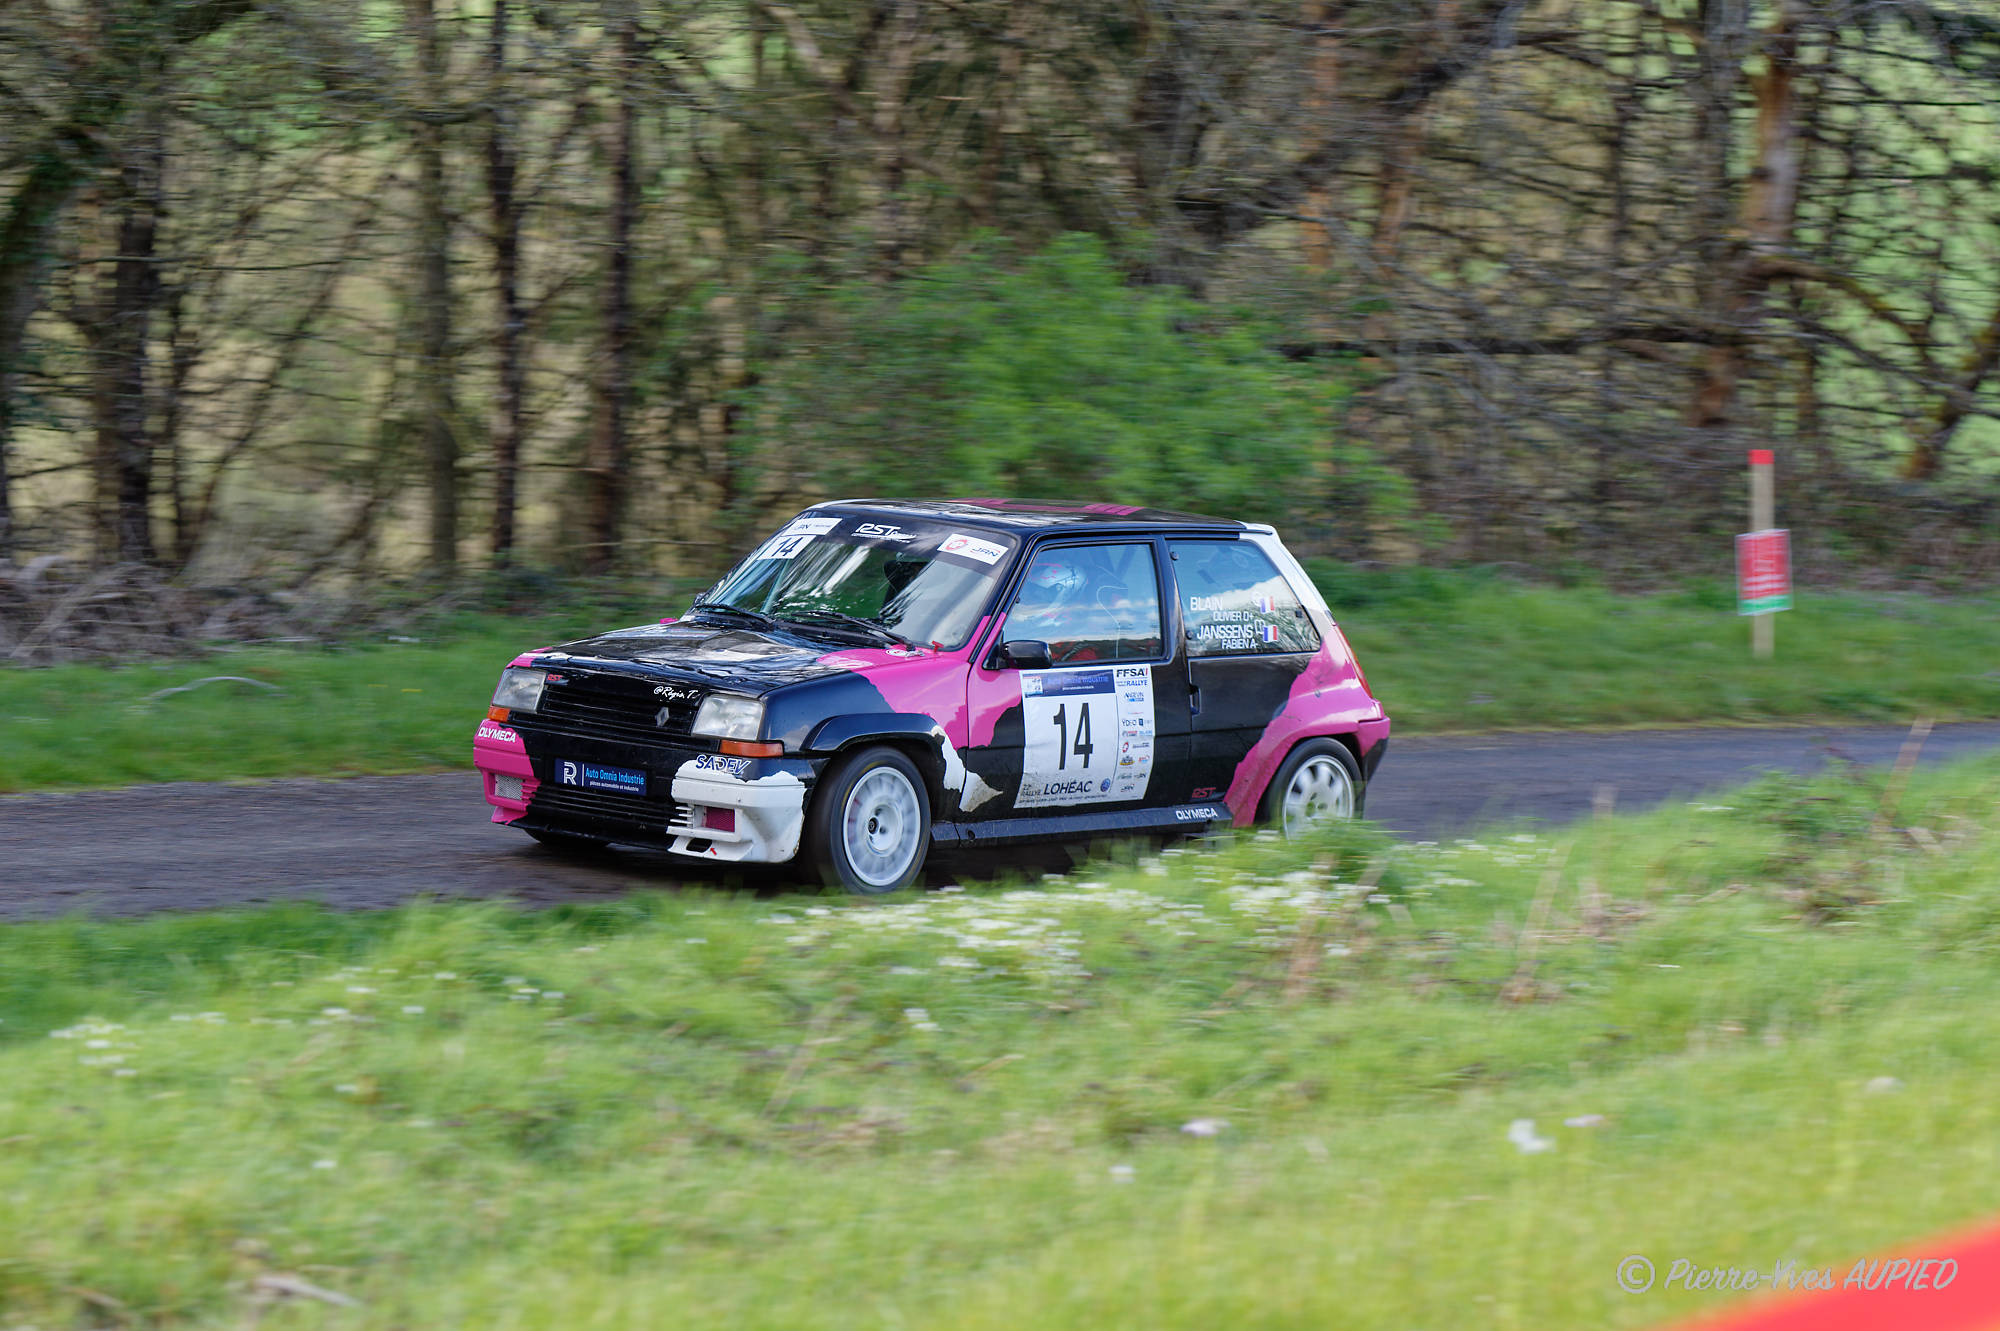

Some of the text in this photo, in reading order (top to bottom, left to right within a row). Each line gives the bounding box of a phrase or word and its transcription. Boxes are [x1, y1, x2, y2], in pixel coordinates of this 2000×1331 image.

[771, 536, 804, 557] 14
[1190, 596, 1223, 611] BLAIN
[1213, 611, 1241, 622] OLIVIER
[1197, 624, 1254, 640] JANSSENS
[1221, 639, 1249, 649] FABIEN
[1116, 668, 1145, 677] FFSA
[478, 727, 517, 743] OLYMECA
[1053, 703, 1094, 770] 14
[695, 754, 752, 775] SADEV
[585, 768, 645, 785] Auto Omnia Industrie
[1043, 780, 1093, 795] LOHÉAC
[1175, 808, 1218, 820] OLYMECA
